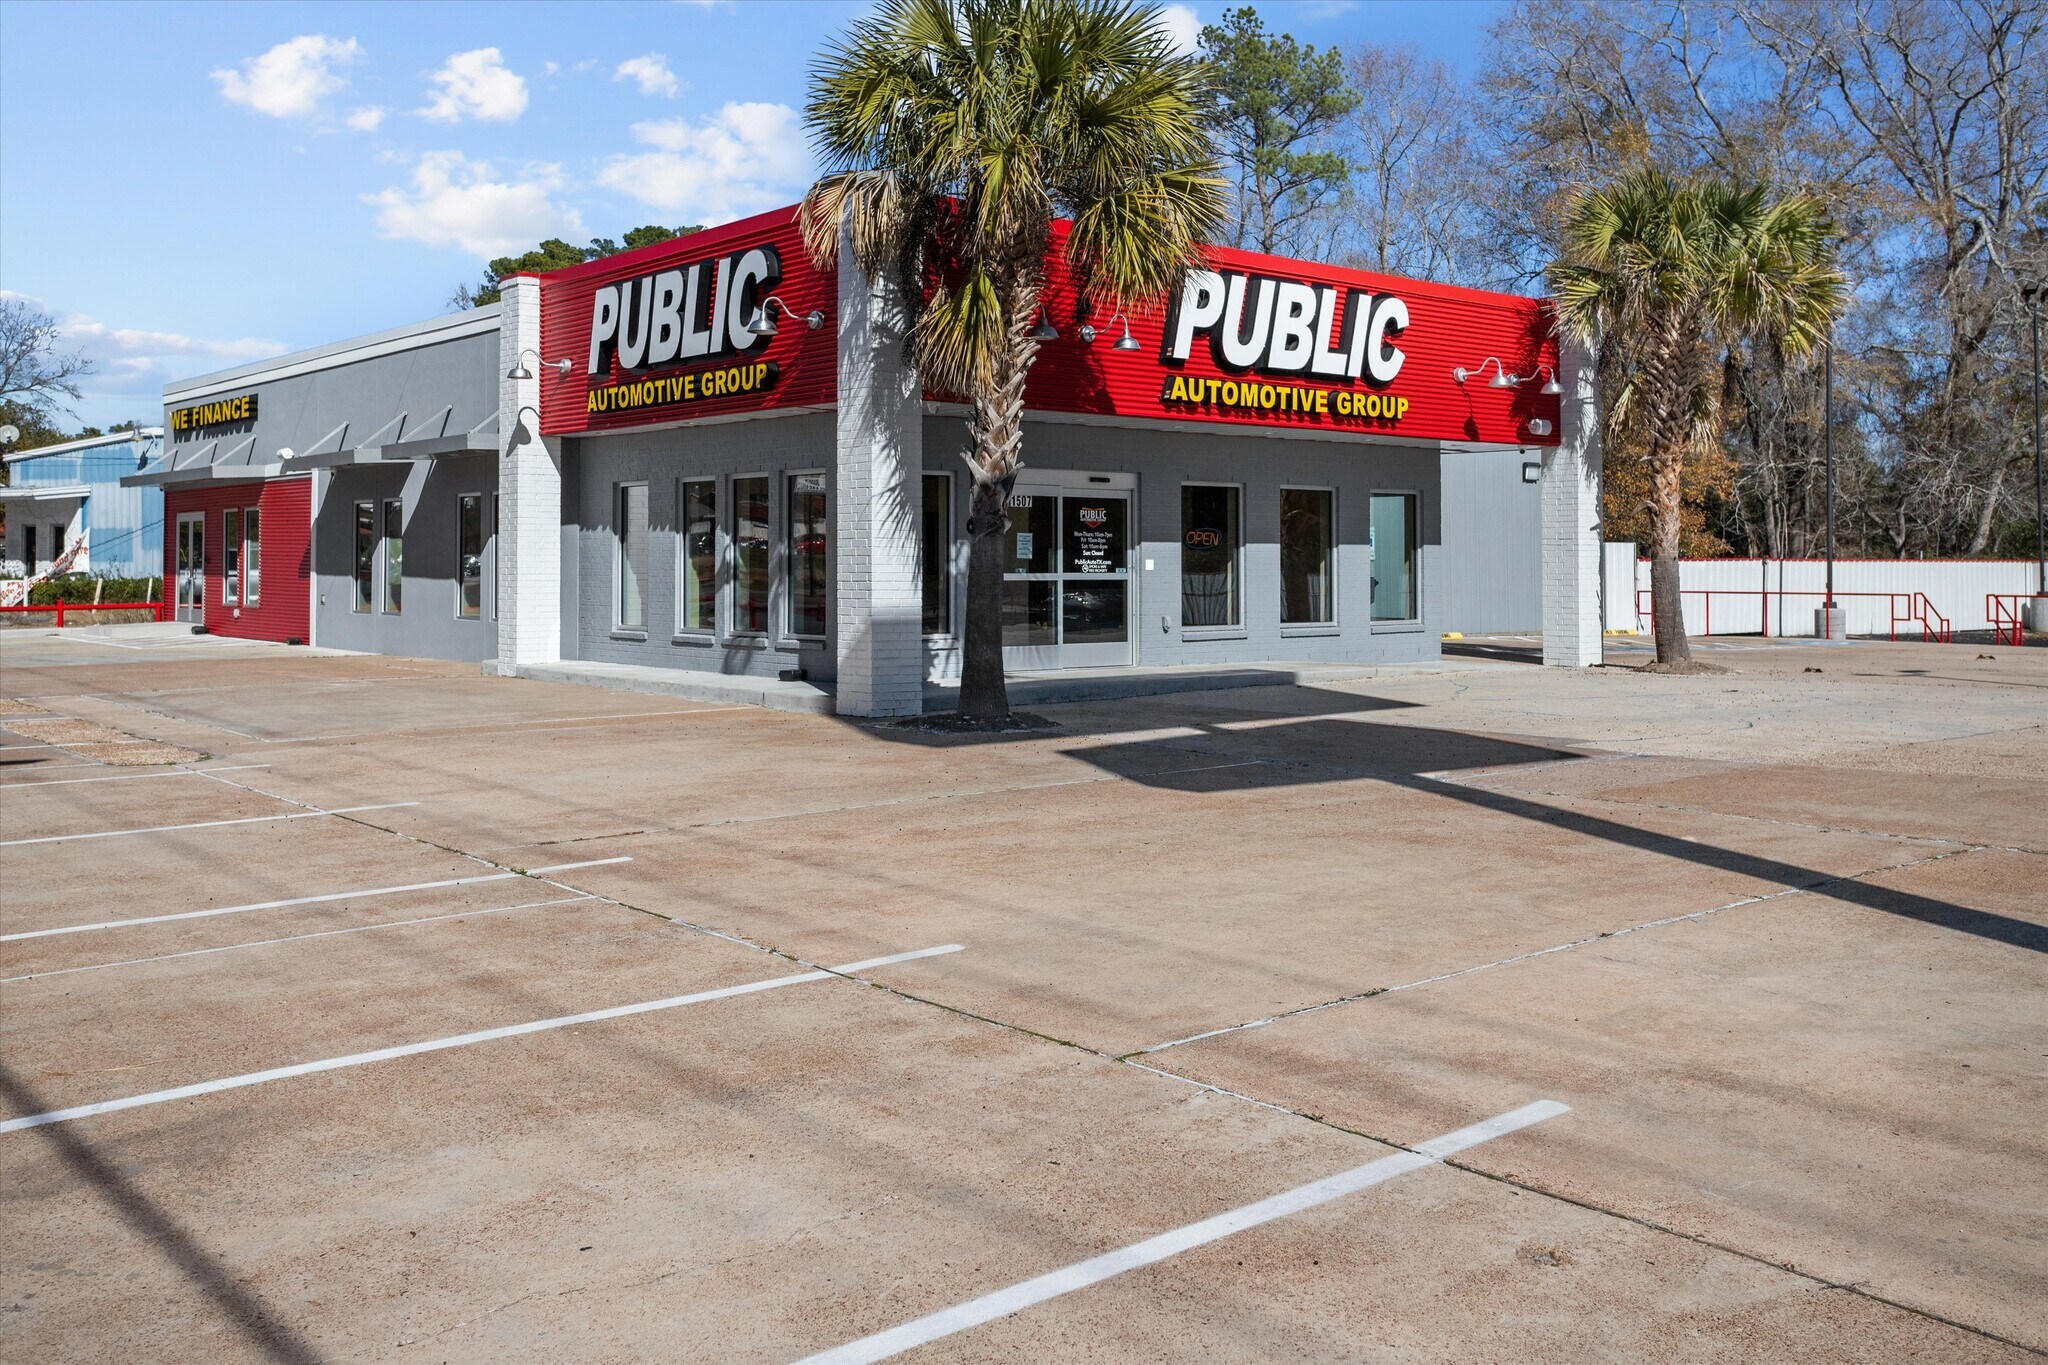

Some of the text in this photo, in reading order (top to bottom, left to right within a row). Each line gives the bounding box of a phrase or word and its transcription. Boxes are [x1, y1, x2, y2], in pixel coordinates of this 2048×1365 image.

[588, 249, 769, 375] PUBLIC
[1173, 268, 1410, 382] PUBLIC
[587, 363, 768, 413] AUTOMOTIVE GROUP
[1170, 376, 1409, 420] AUTOMOTIVE GROUP
[169, 396, 250, 430] WE FINANCE
[1011, 495, 1032, 507] 1507
[1080, 509, 1107, 519] PUBLIC
[1186, 531, 1220, 546] OPEN
